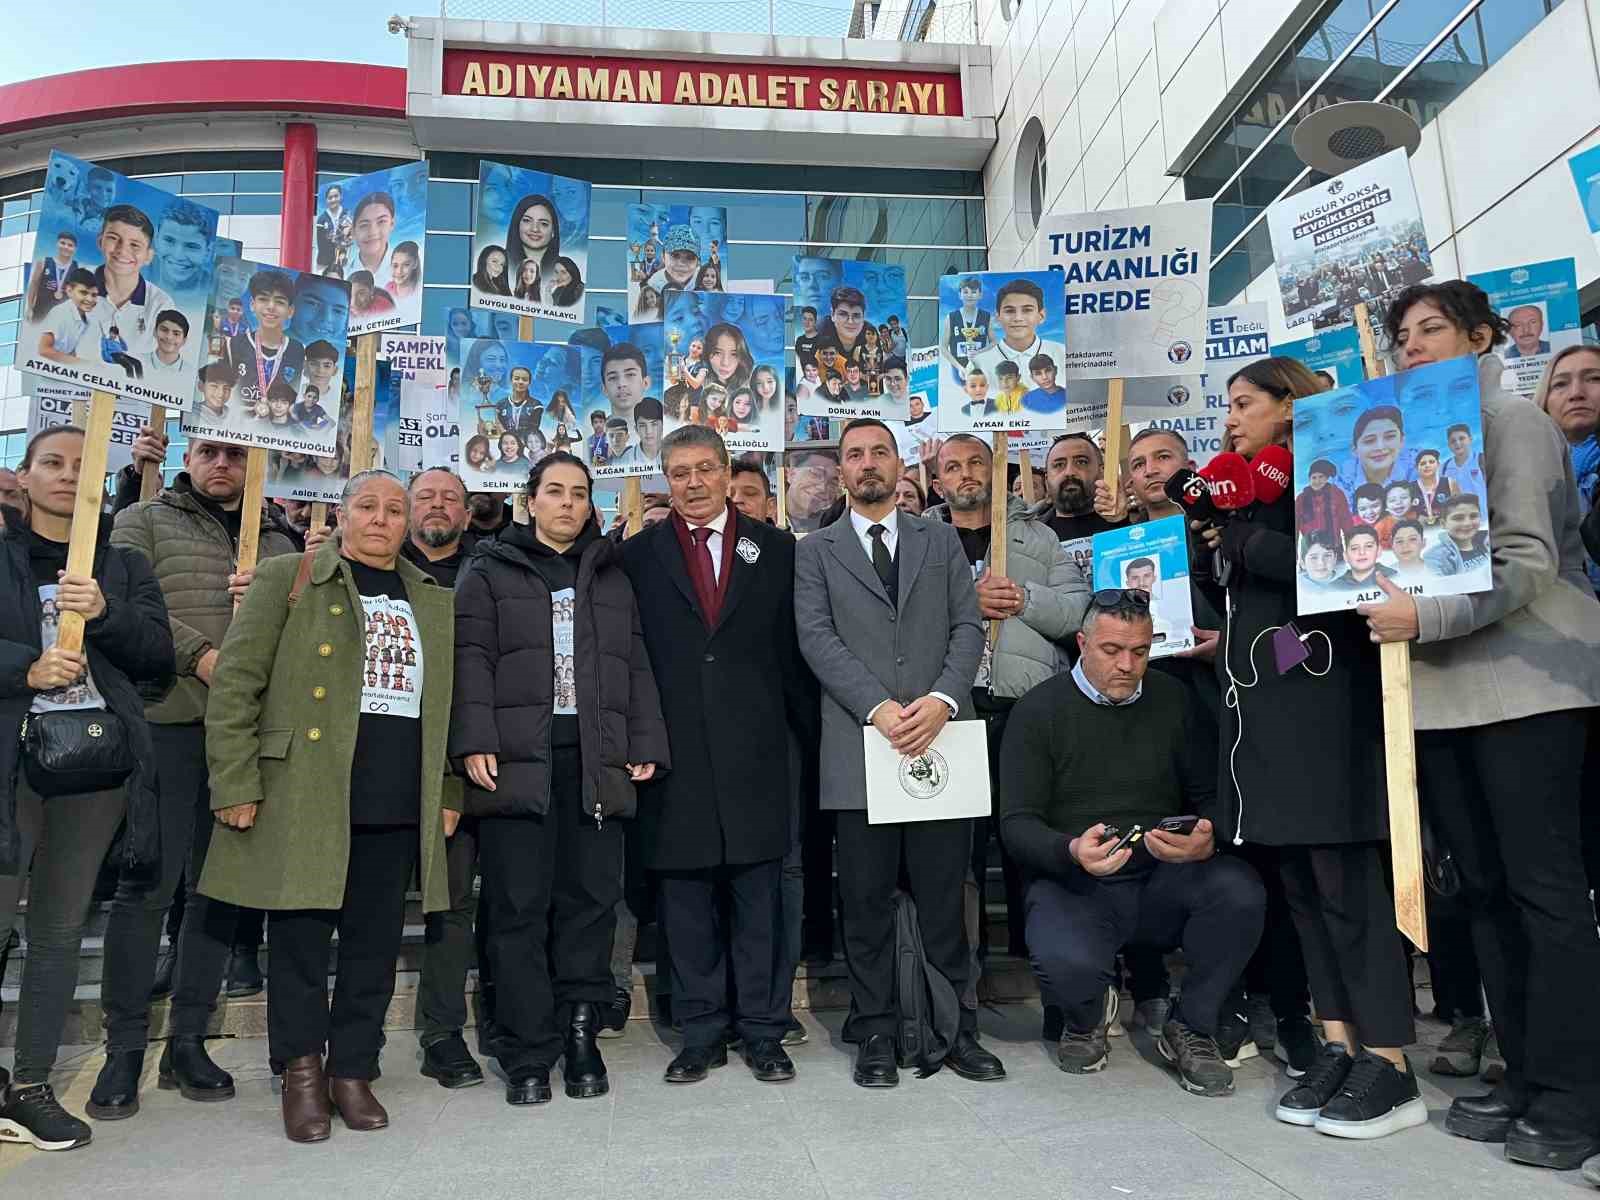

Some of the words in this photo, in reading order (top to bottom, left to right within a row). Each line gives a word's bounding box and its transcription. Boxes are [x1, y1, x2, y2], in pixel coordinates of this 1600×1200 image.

[461, 61, 662, 103] ADIYAMAN
[673, 71, 810, 110] ADALET
[818, 78, 946, 115] SARAYI
[1299, 200, 1338, 222] KUSUR
[1339, 183, 1380, 207] YOKSA
[1295, 191, 1390, 239] SEVDİKLERİMİZ
[1315, 214, 1374, 244] NEREDE?
[1048, 224, 1151, 255] TURİZM
[479, 298, 508, 308] DUYGU
[1065, 288, 1151, 316] EREDE
[1205, 316, 1237, 336] ET
[385, 339, 446, 354] ŞAMPİY
[1206, 338, 1267, 359] TLİAM
[26, 358, 79, 380] ATAKAN
[82, 373, 122, 391] CELAL
[125, 384, 183, 406] KONUKLU
[1200, 373, 1209, 388] T
[828, 407, 857, 416] DORUK
[860, 408, 882, 417] AKIN
[425, 424, 460, 438] OLA
[972, 419, 1004, 429] AYKAN
[1008, 419, 1031, 428] EKİZ
[182, 423, 213, 438] MERT
[216, 427, 253, 442] NİYAZİ
[256, 434, 336, 455] TOPUKÇUOĞLU
[722, 438, 769, 450] ÇALİOĞLU
[482, 481, 509, 489] SELİN
[513, 482, 530, 490] KA
[1356, 590, 1382, 602] ALP
